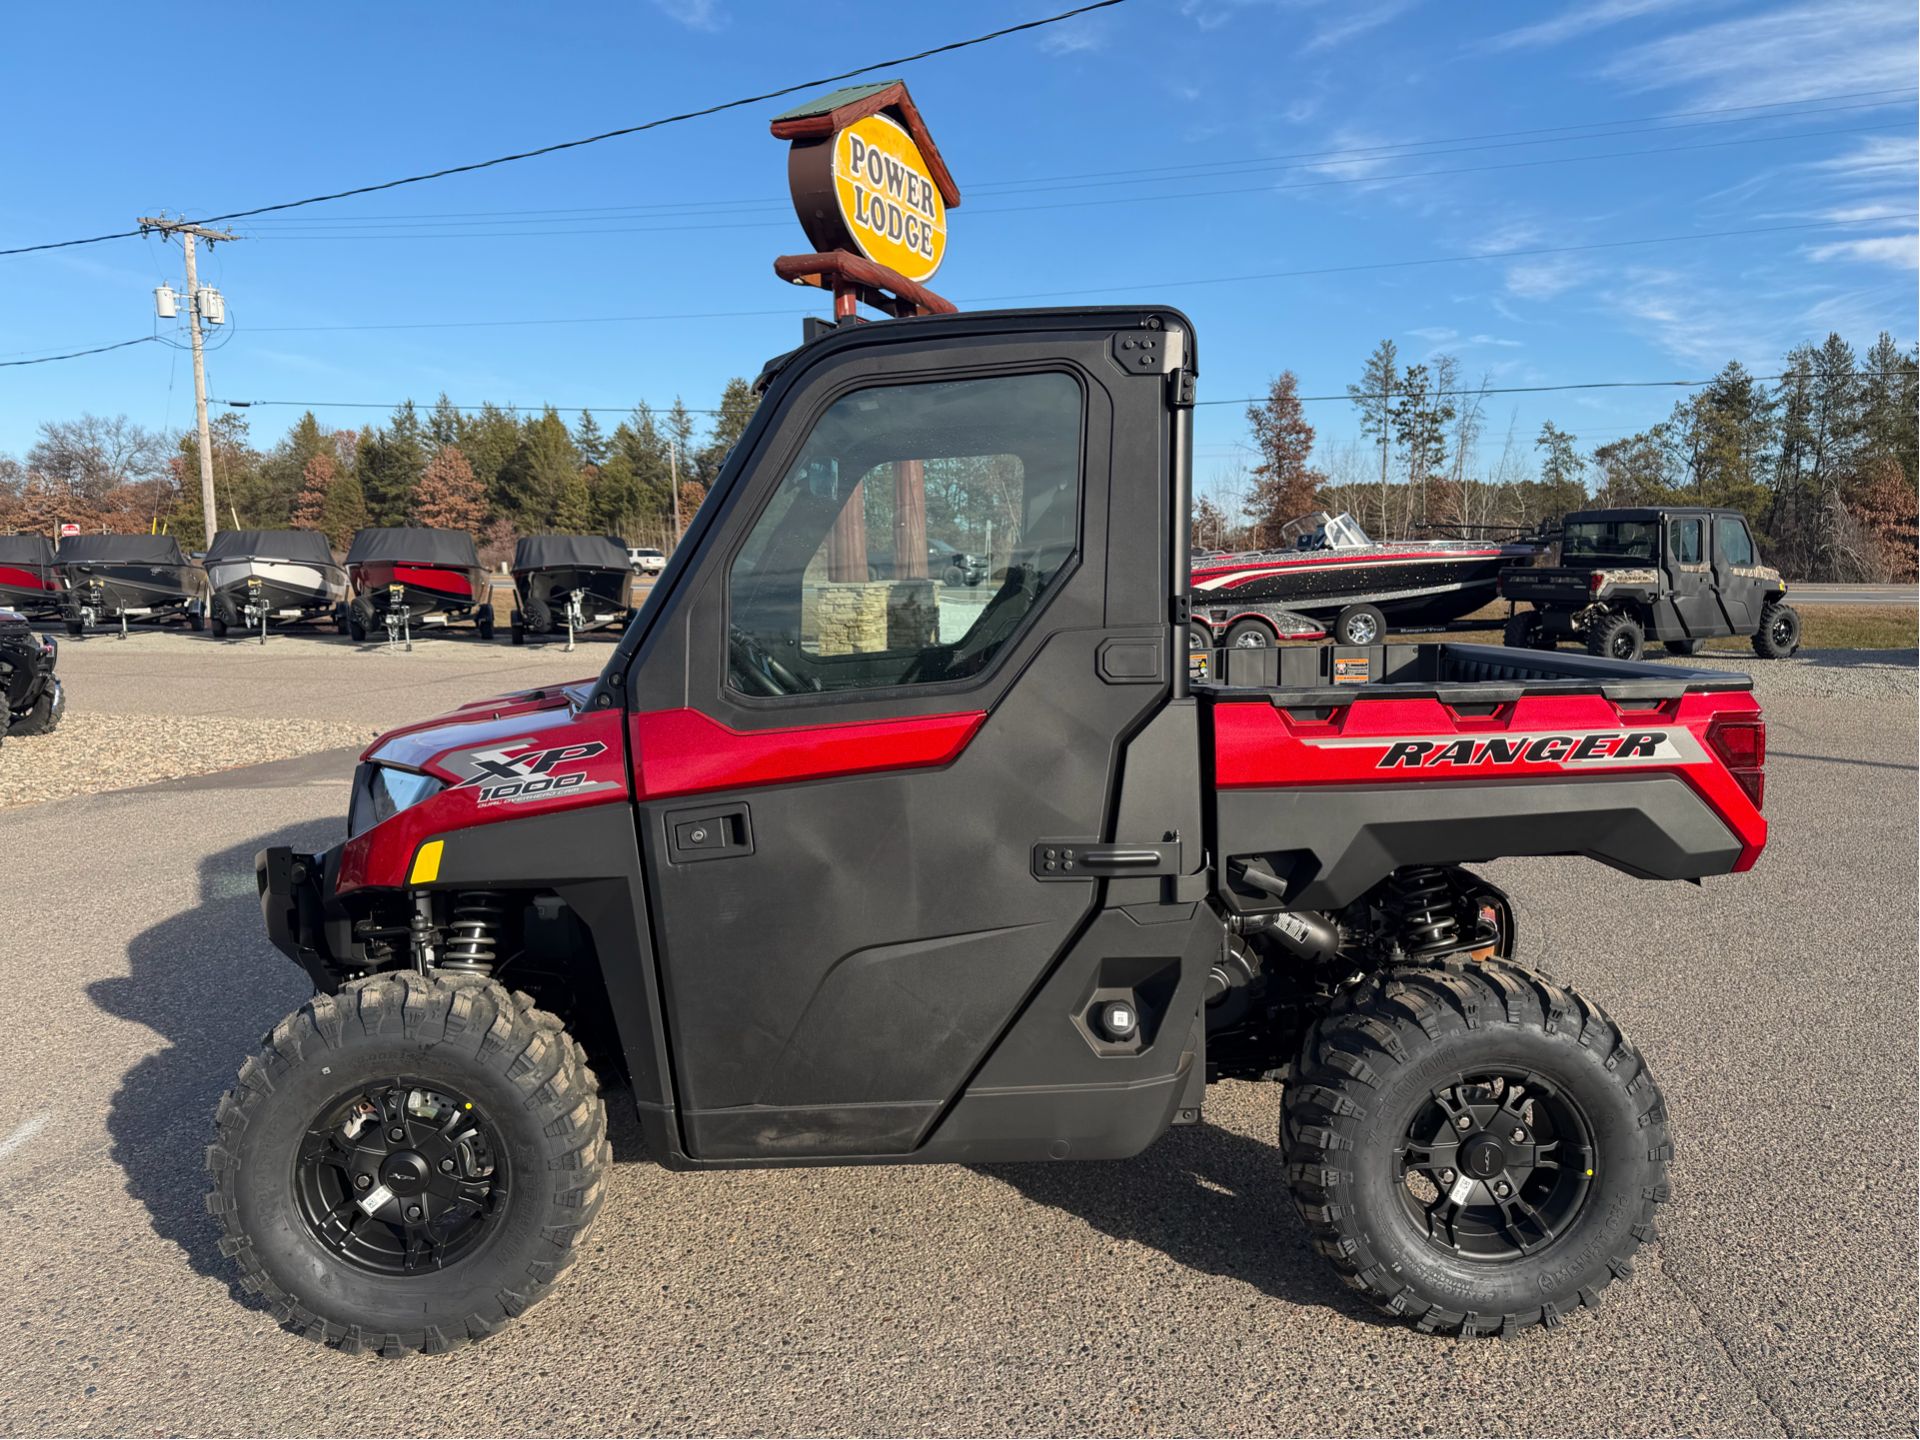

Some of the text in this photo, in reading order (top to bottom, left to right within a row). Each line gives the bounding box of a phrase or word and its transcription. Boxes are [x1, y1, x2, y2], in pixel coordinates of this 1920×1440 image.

[849, 135, 935, 218] POWER
[854, 184, 934, 257] LODGE
[447, 741, 608, 790] XP
[1376, 731, 1668, 769] RANGER
[476, 771, 587, 804] 1000
